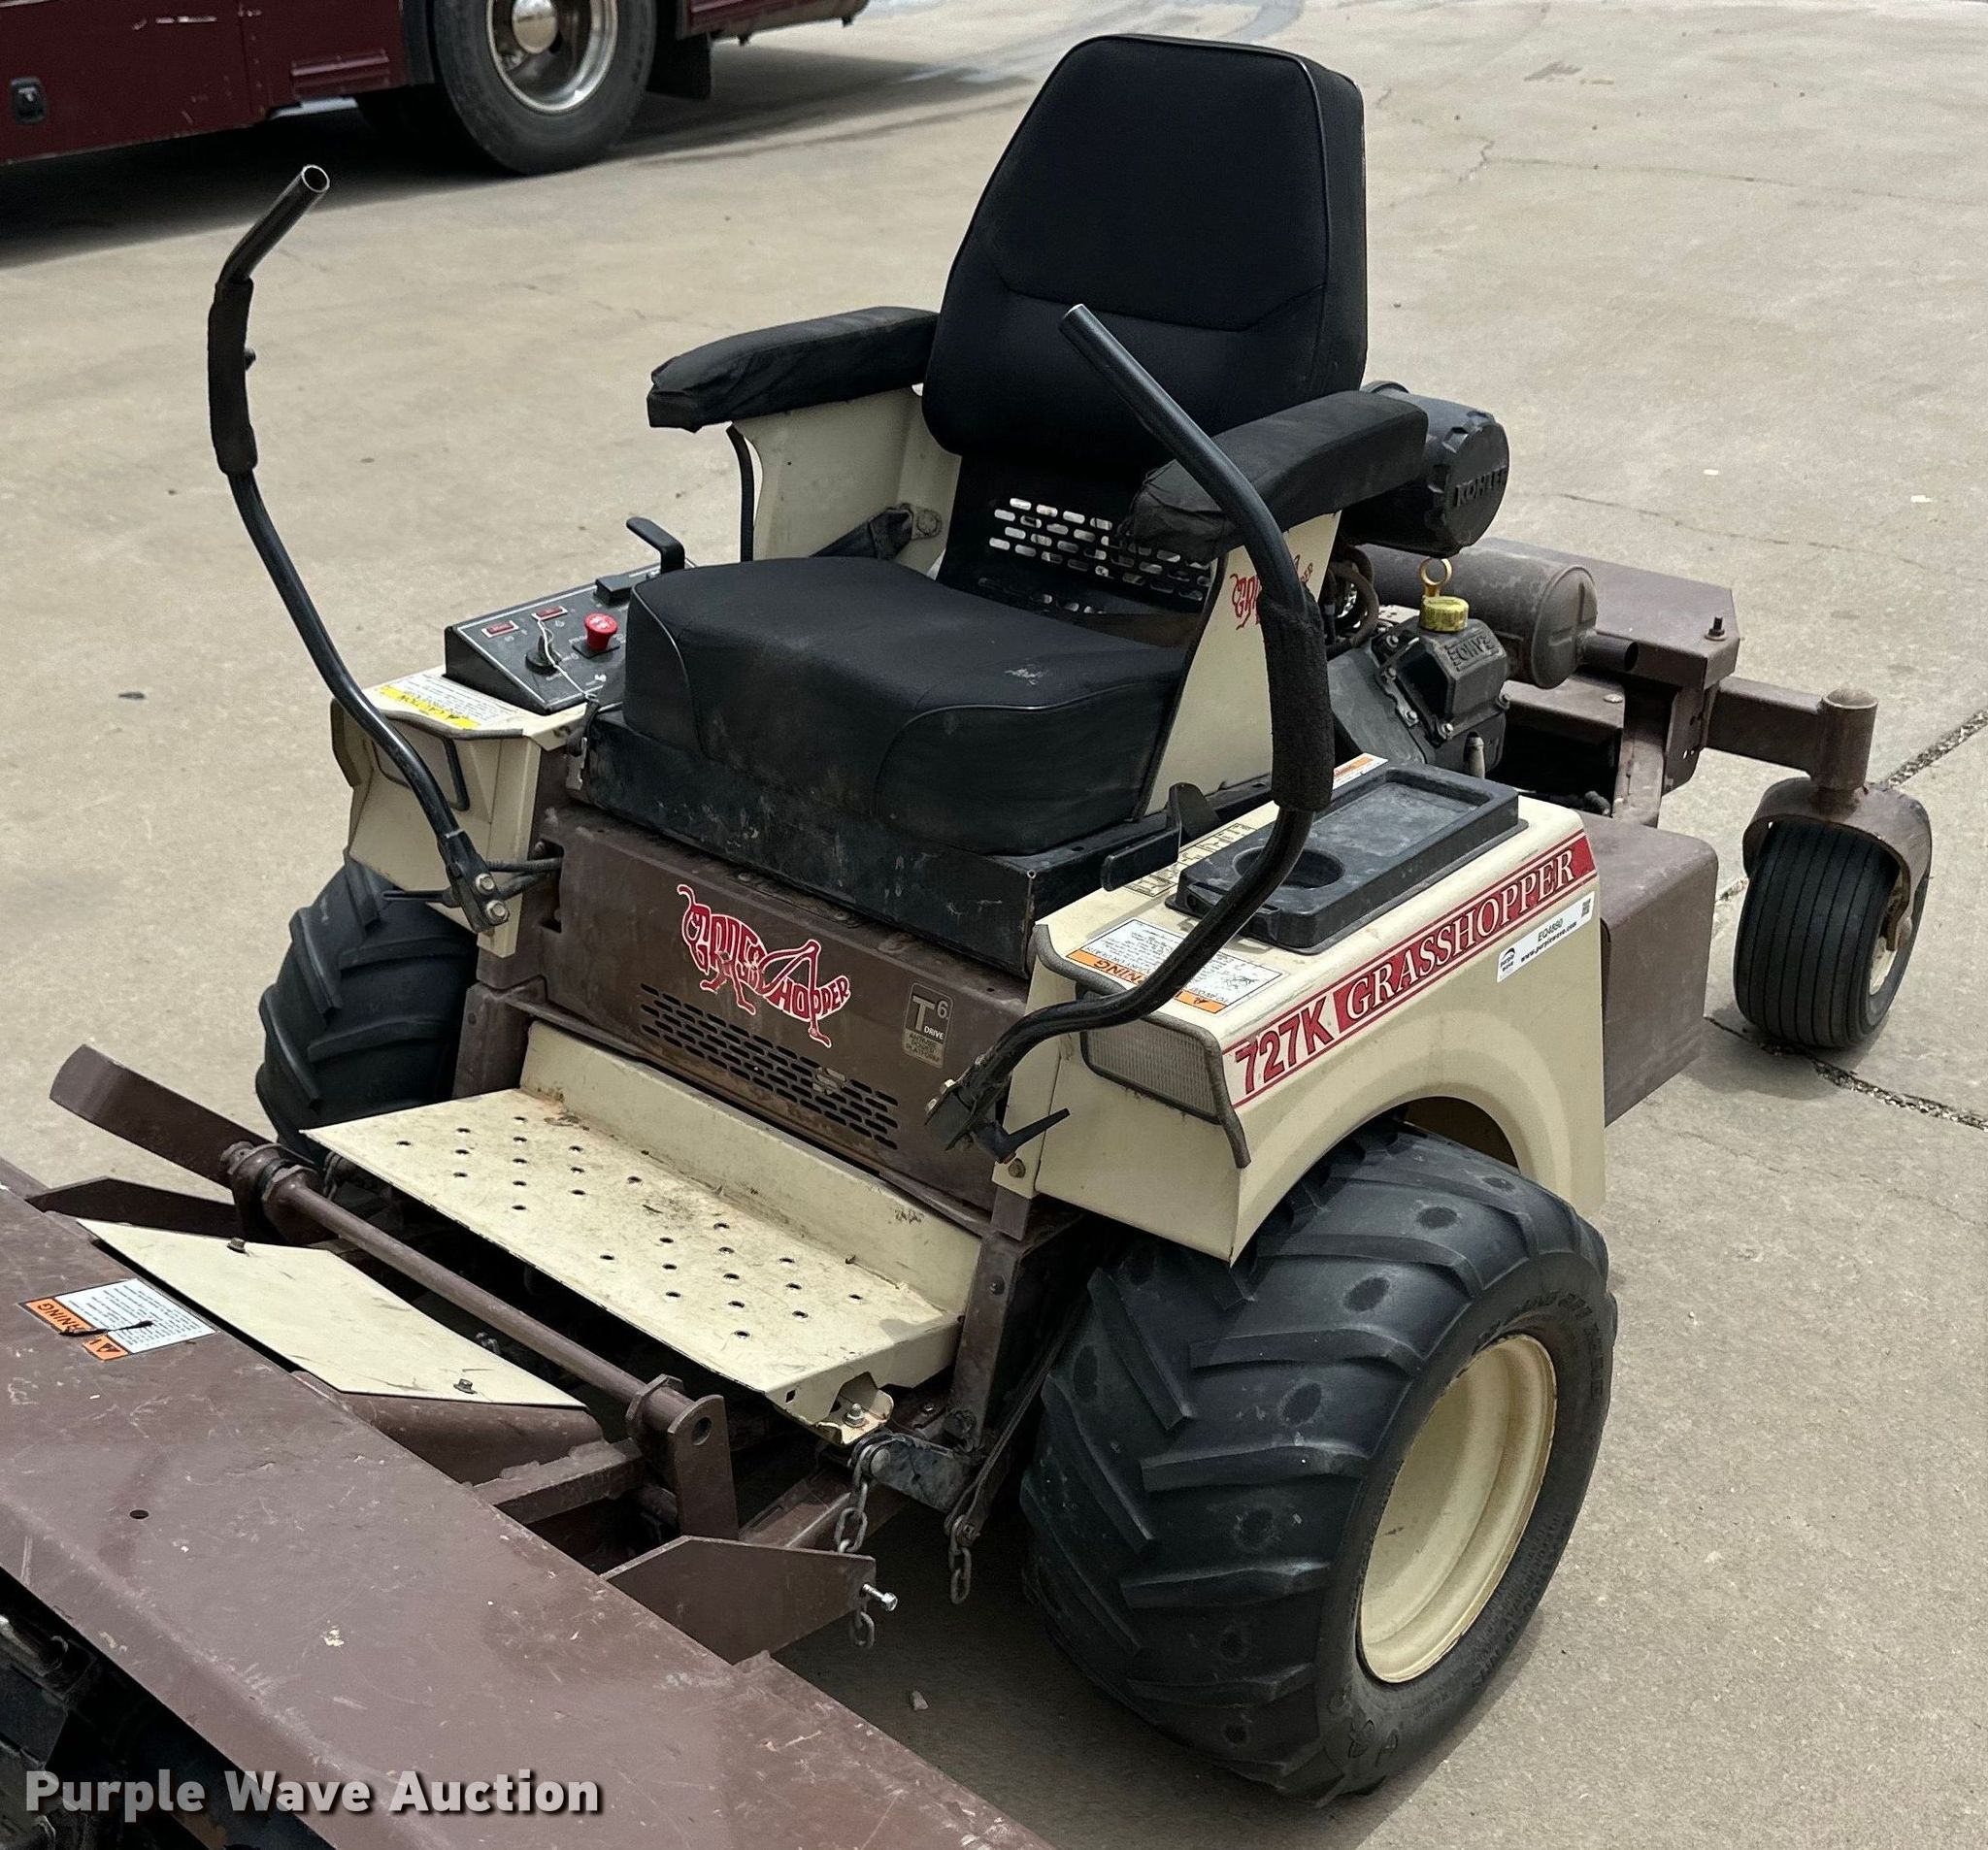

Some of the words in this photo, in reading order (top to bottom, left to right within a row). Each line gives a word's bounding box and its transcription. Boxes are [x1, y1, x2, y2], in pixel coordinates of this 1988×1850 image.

[1346, 848, 1575, 1021] GRASSHOPPER
[923, 1025, 945, 1041] DRIVE
[1235, 996, 1336, 1096] 727K
